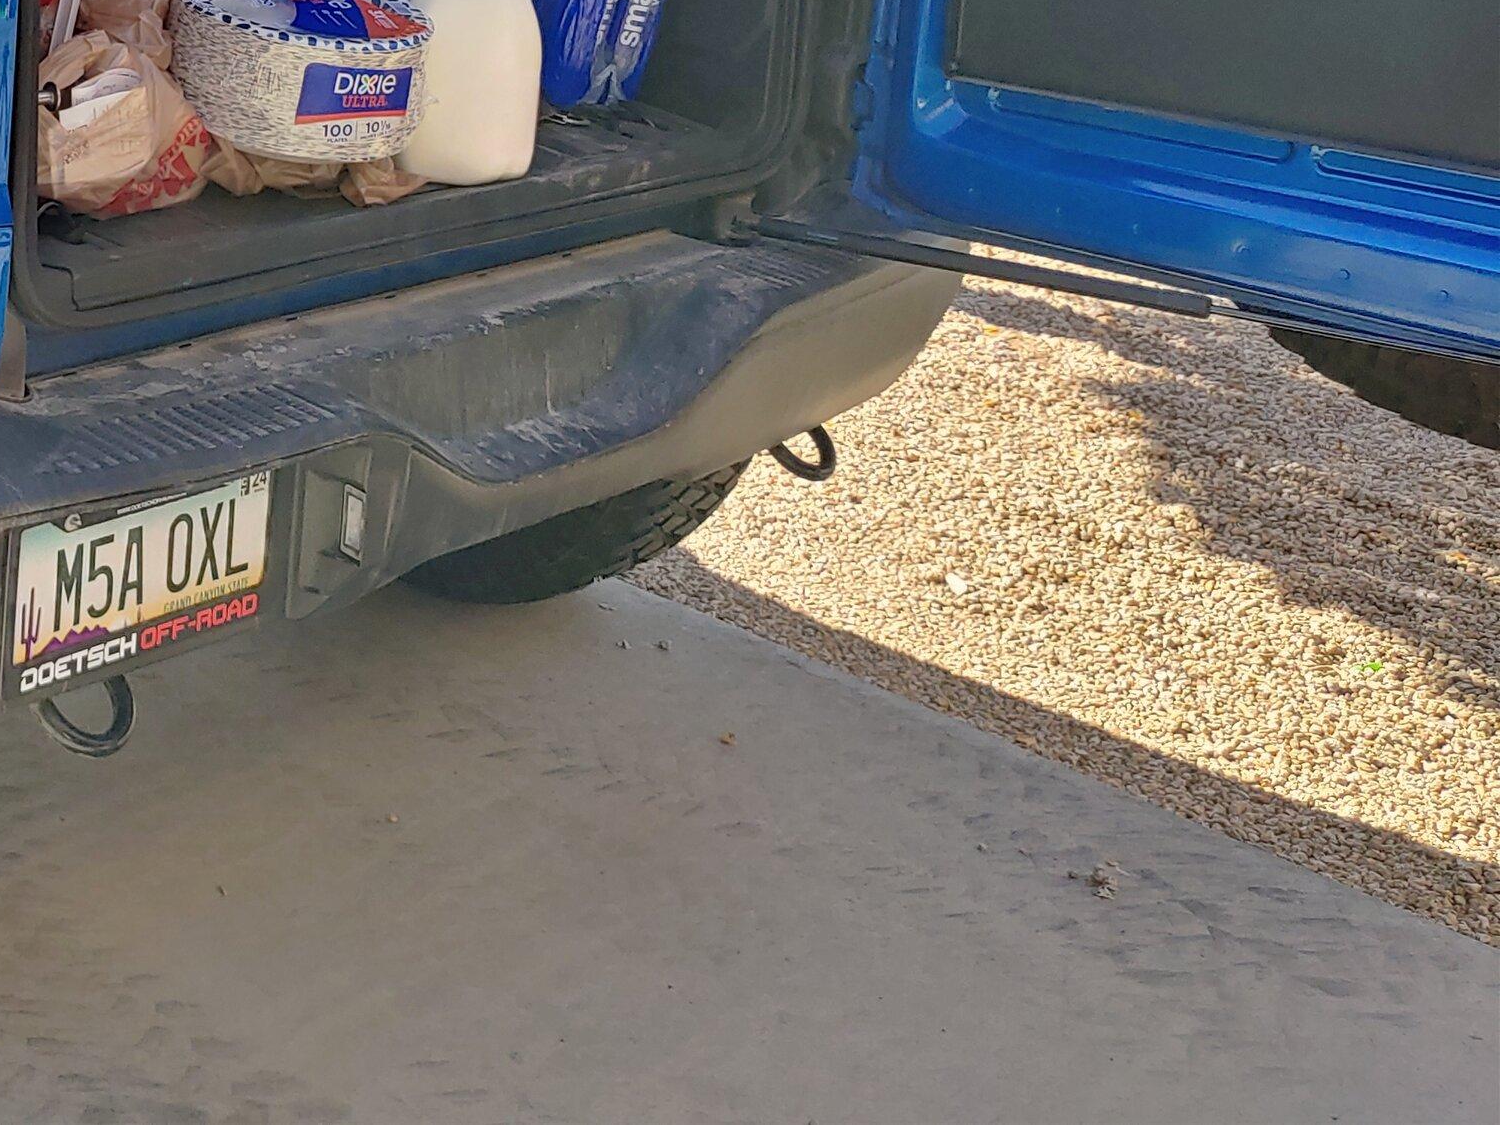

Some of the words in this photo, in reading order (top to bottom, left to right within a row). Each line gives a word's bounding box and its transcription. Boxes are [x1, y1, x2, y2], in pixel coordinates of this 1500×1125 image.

[342, 94, 388, 108] ULTRA
[321, 123, 353, 138] 100
[365, 121, 380, 134] 10
[53, 525, 144, 633] M5A
[162, 596, 193, 614] GRAND
[194, 585, 227, 607] CANYON
[227, 577, 250, 595] STATE
[19, 632, 138, 694] DOETSCH
[139, 592, 260, 651] OFF-ROAD
